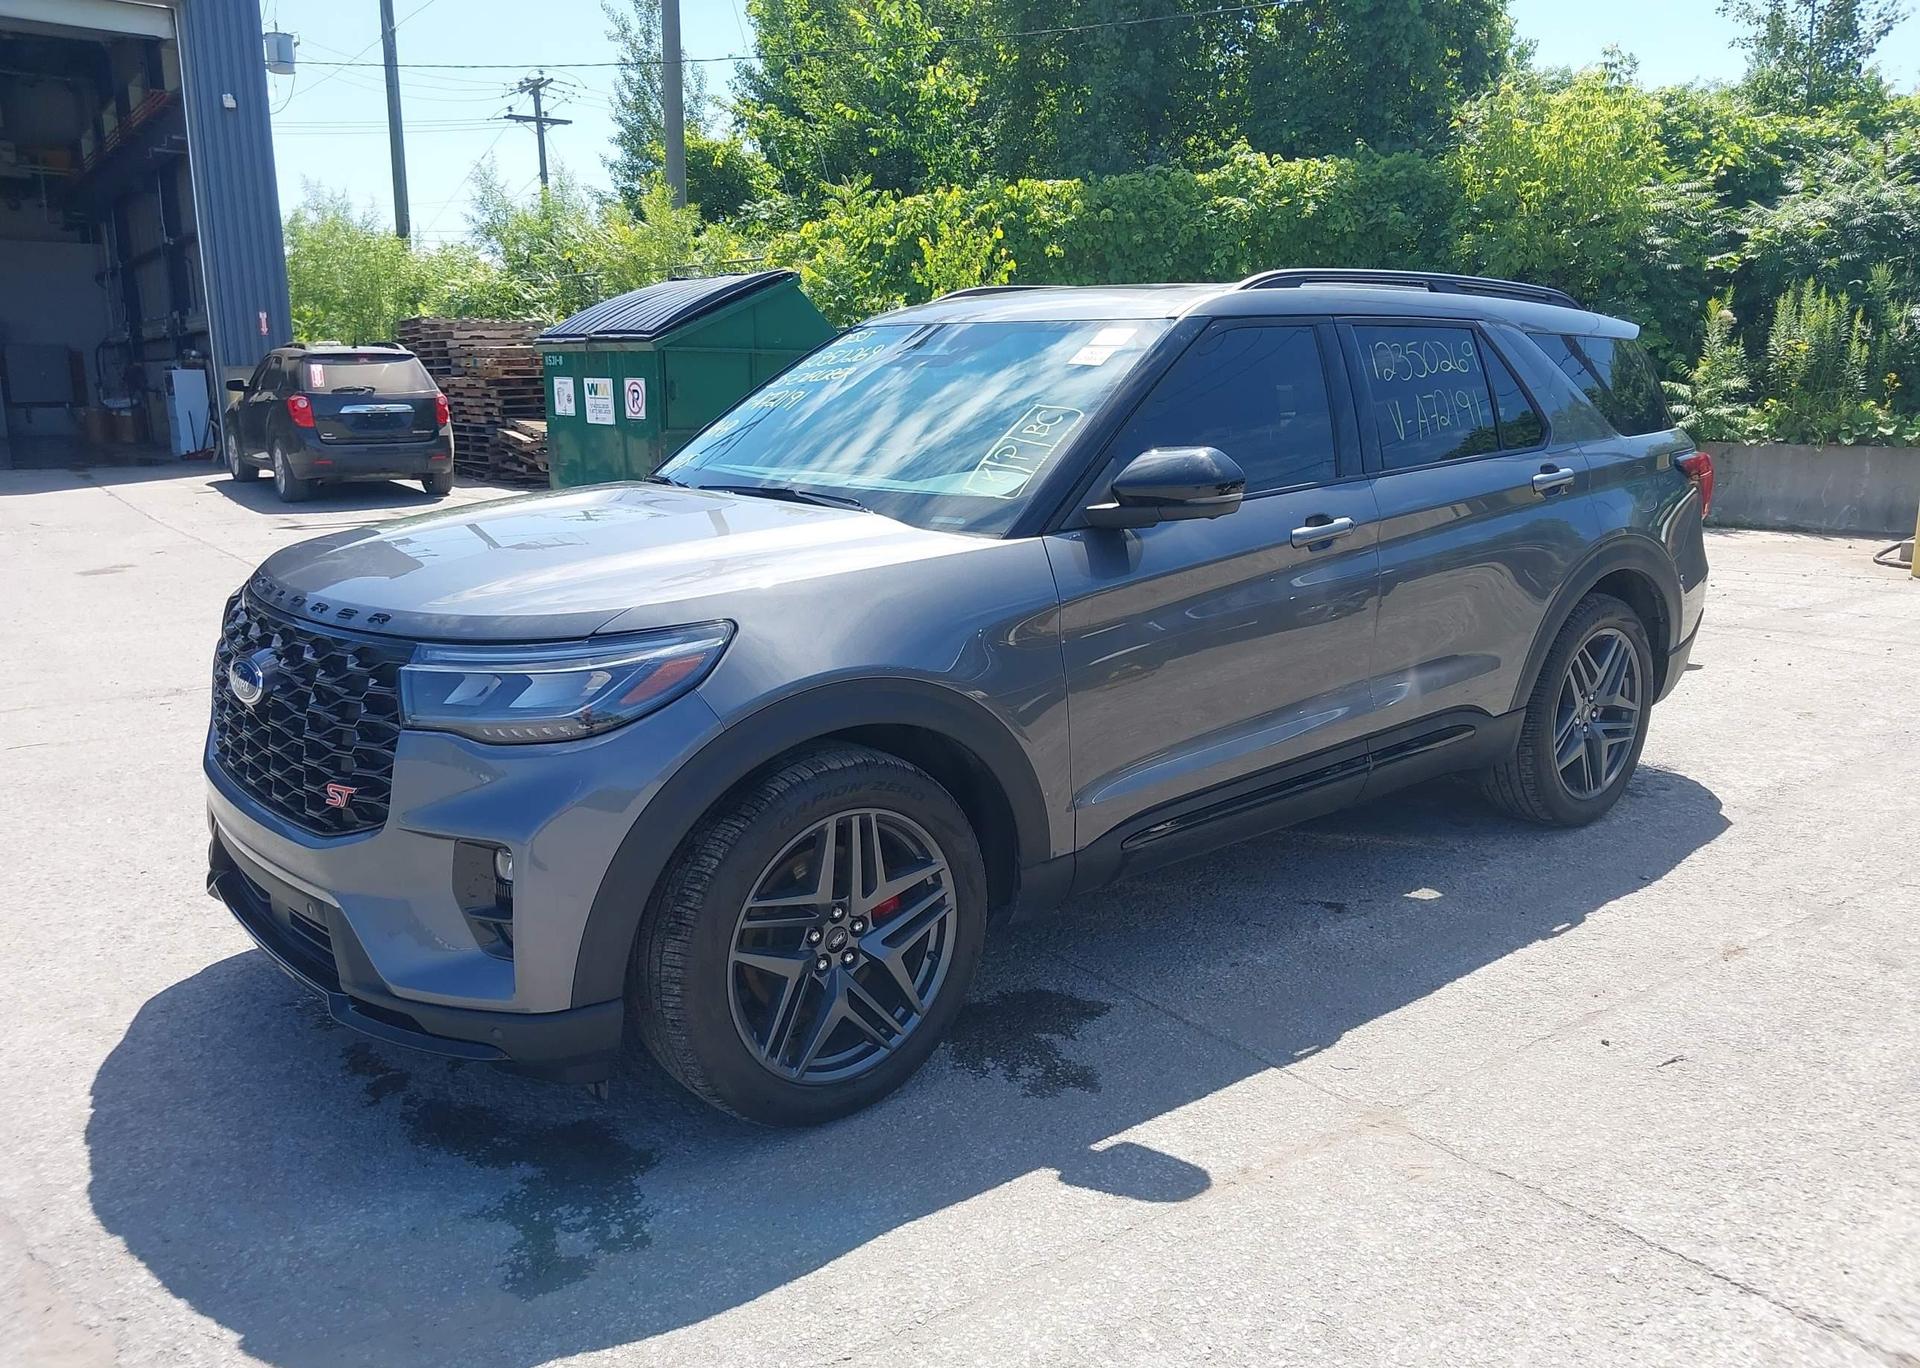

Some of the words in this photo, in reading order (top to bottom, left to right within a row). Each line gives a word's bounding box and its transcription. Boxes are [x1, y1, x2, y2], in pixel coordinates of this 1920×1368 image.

[1368, 340, 1480, 382] 12350269
[587, 382, 609, 396] WM
[325, 783, 357, 808] ST
